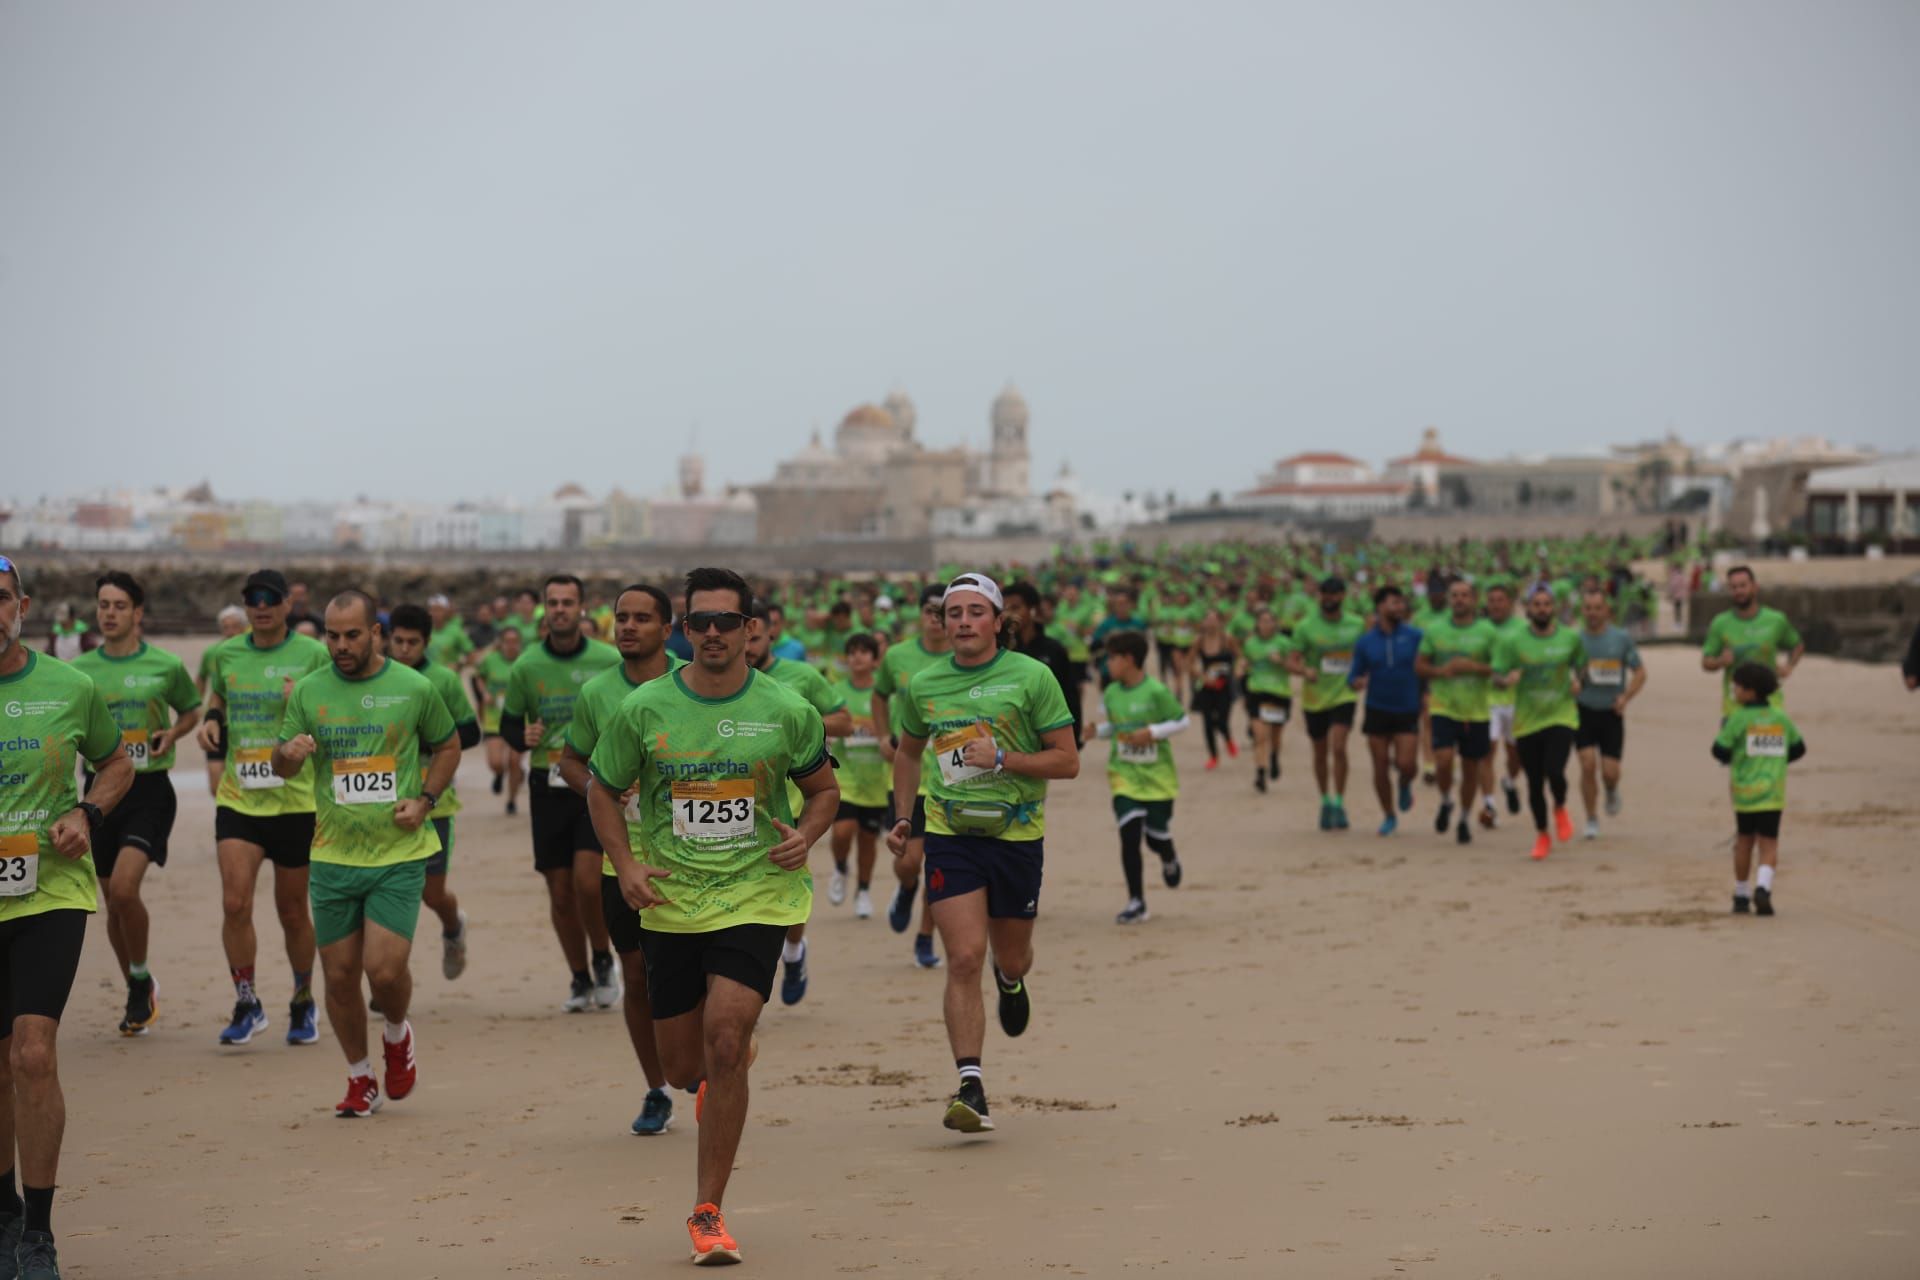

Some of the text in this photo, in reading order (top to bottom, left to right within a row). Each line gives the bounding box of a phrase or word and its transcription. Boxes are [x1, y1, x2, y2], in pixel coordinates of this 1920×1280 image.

[318, 723, 384, 736] En marcha
[655, 758, 749, 776] En marcha
[342, 772, 393, 793] 1025
[682, 797, 750, 824] 1253
